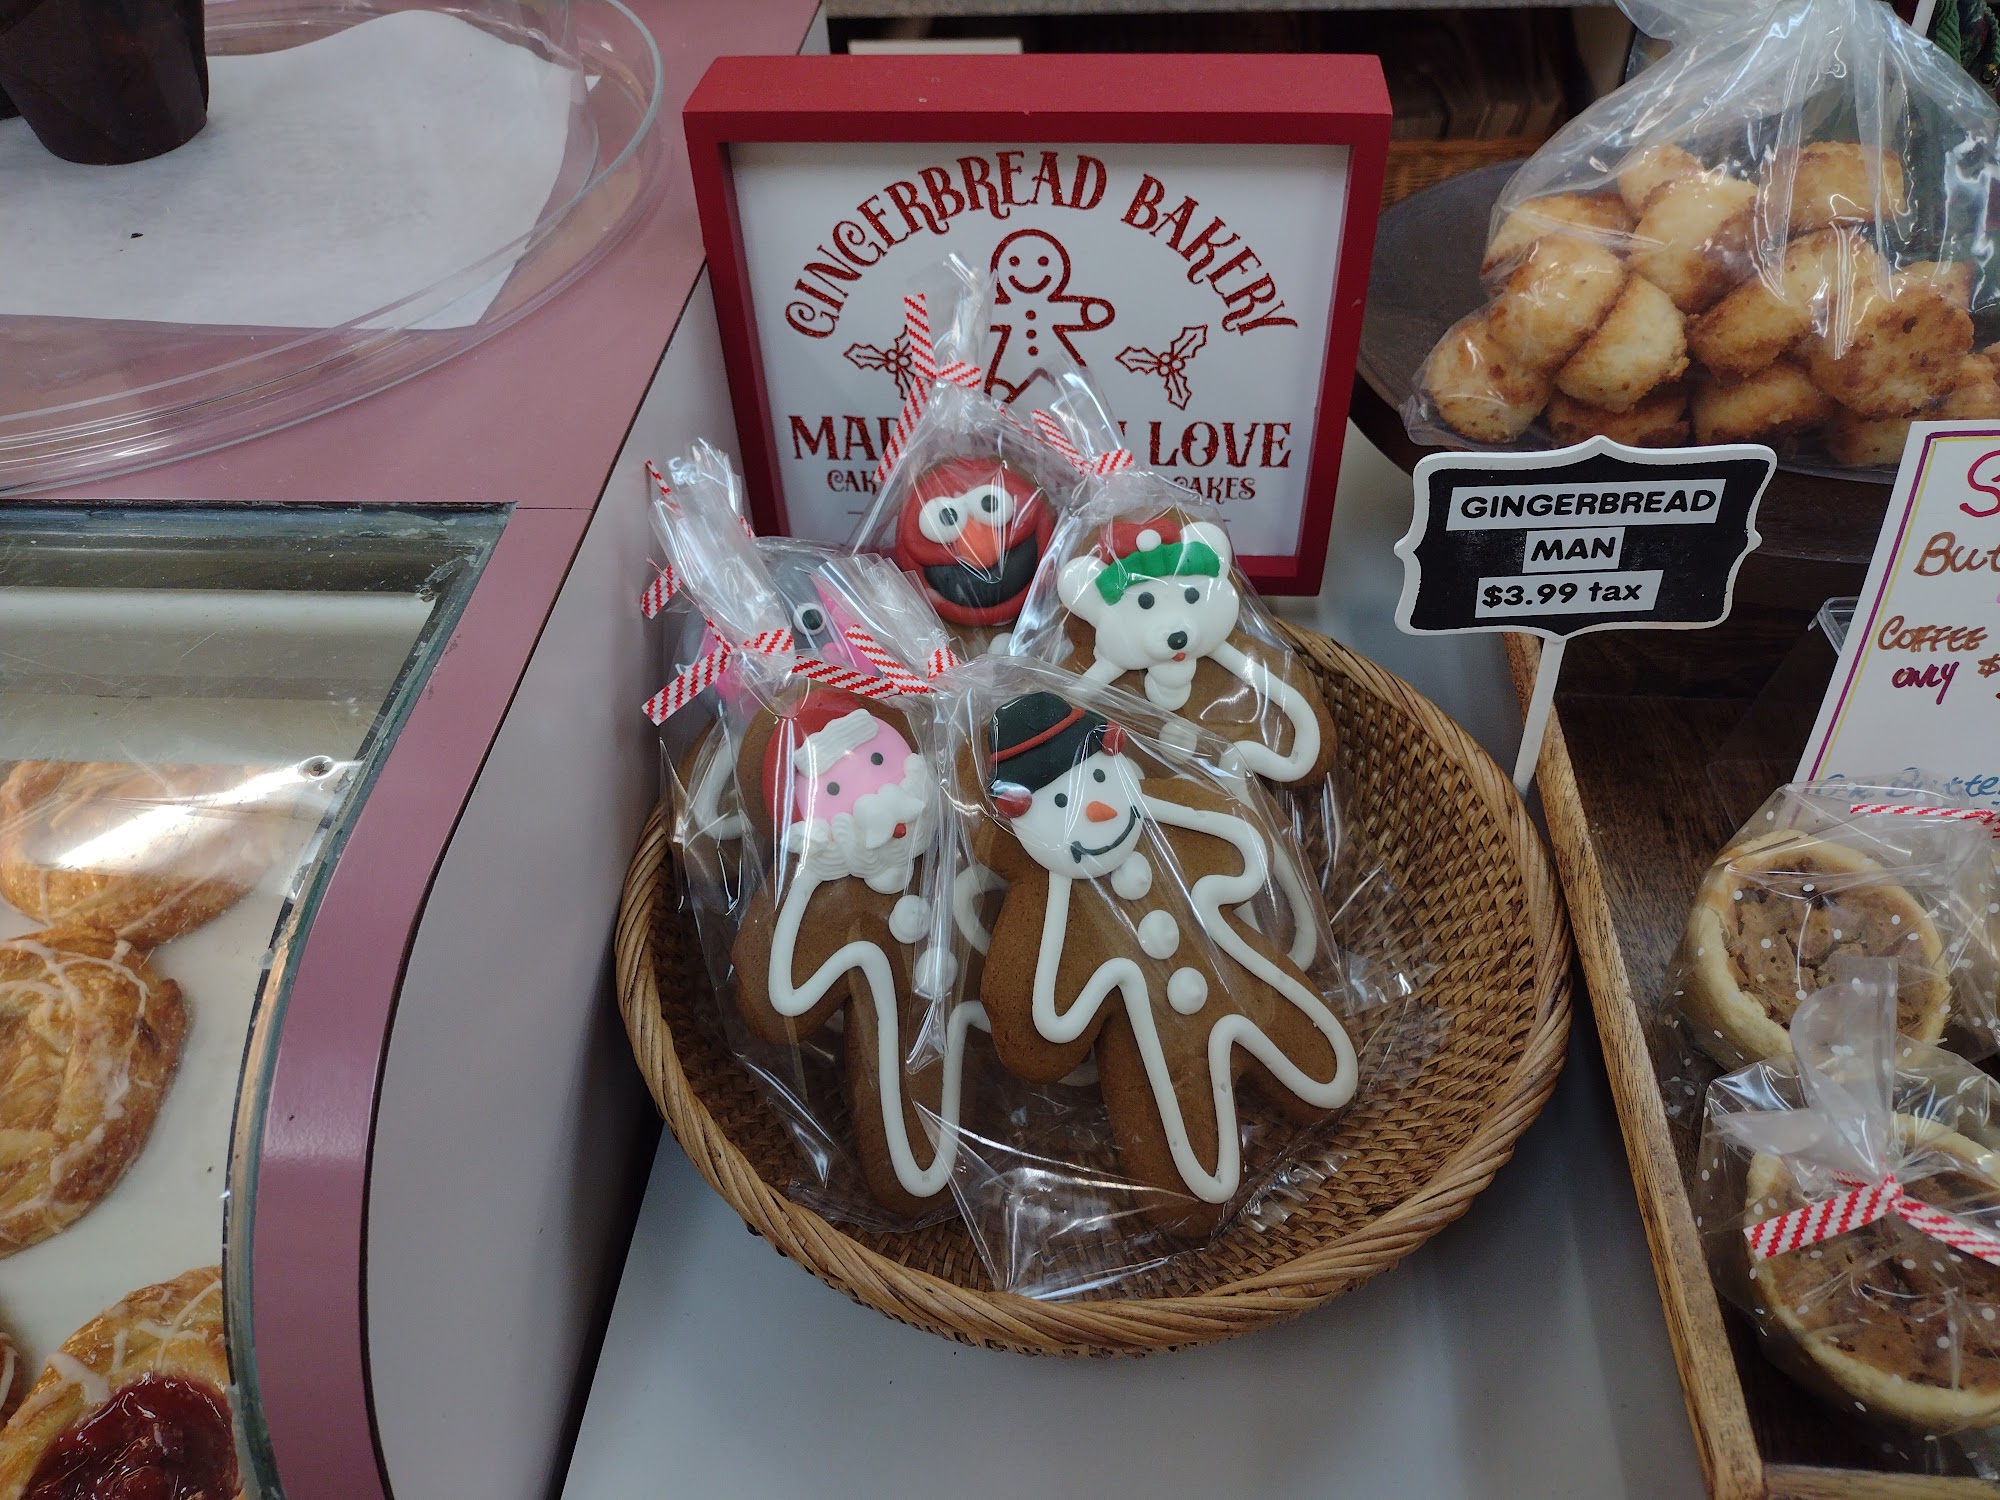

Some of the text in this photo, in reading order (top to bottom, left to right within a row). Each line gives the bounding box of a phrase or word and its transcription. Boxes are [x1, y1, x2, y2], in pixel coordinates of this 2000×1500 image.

[785, 150, 1298, 338] GINGERBREAD BAKERY
[1148, 421, 1291, 468] LOVE
[1460, 489, 1717, 519] GINGERBREAD
[1530, 536, 1616, 562] MAN
[1481, 581, 1643, 609] $3.99 tax
